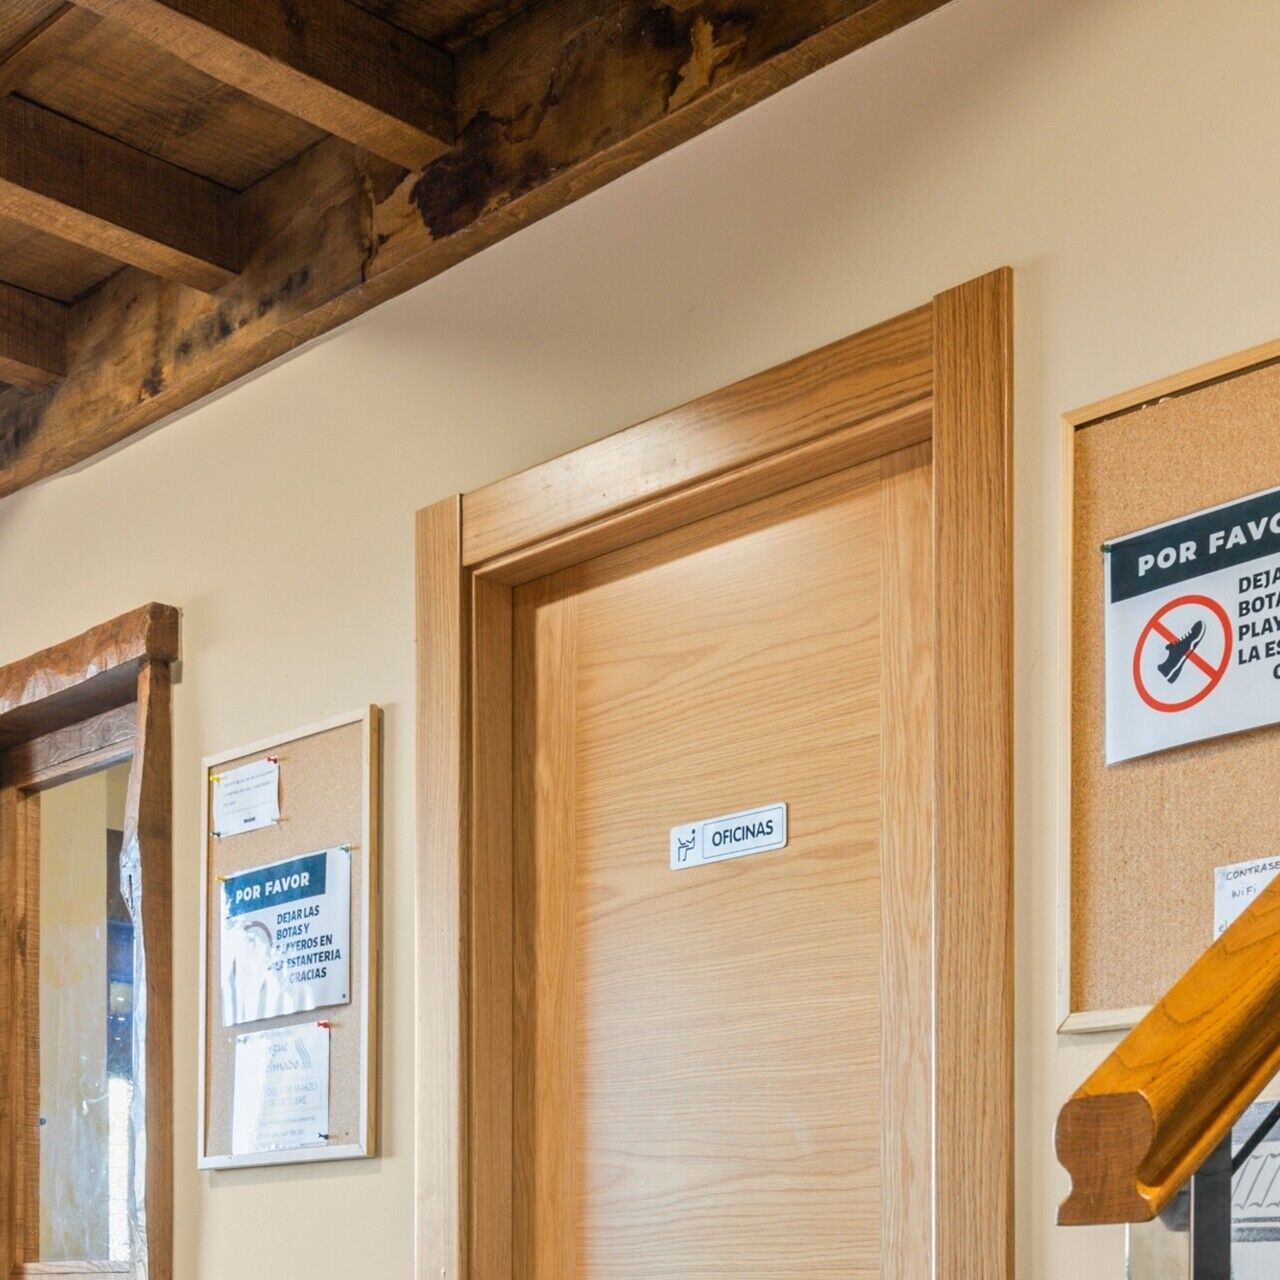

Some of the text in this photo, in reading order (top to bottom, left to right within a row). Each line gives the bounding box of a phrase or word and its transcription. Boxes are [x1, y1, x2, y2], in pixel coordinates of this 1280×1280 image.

[1137, 540, 1198, 577] POR
[1238, 644, 1261, 666] LA
[711, 819, 774, 847] OFICINAS
[236, 872, 310, 904] POR FAVOR
[276, 905, 320, 925] DEJAR LAS
[276, 923, 310, 940] BOTAS Y
[320, 934, 333, 946] EN
